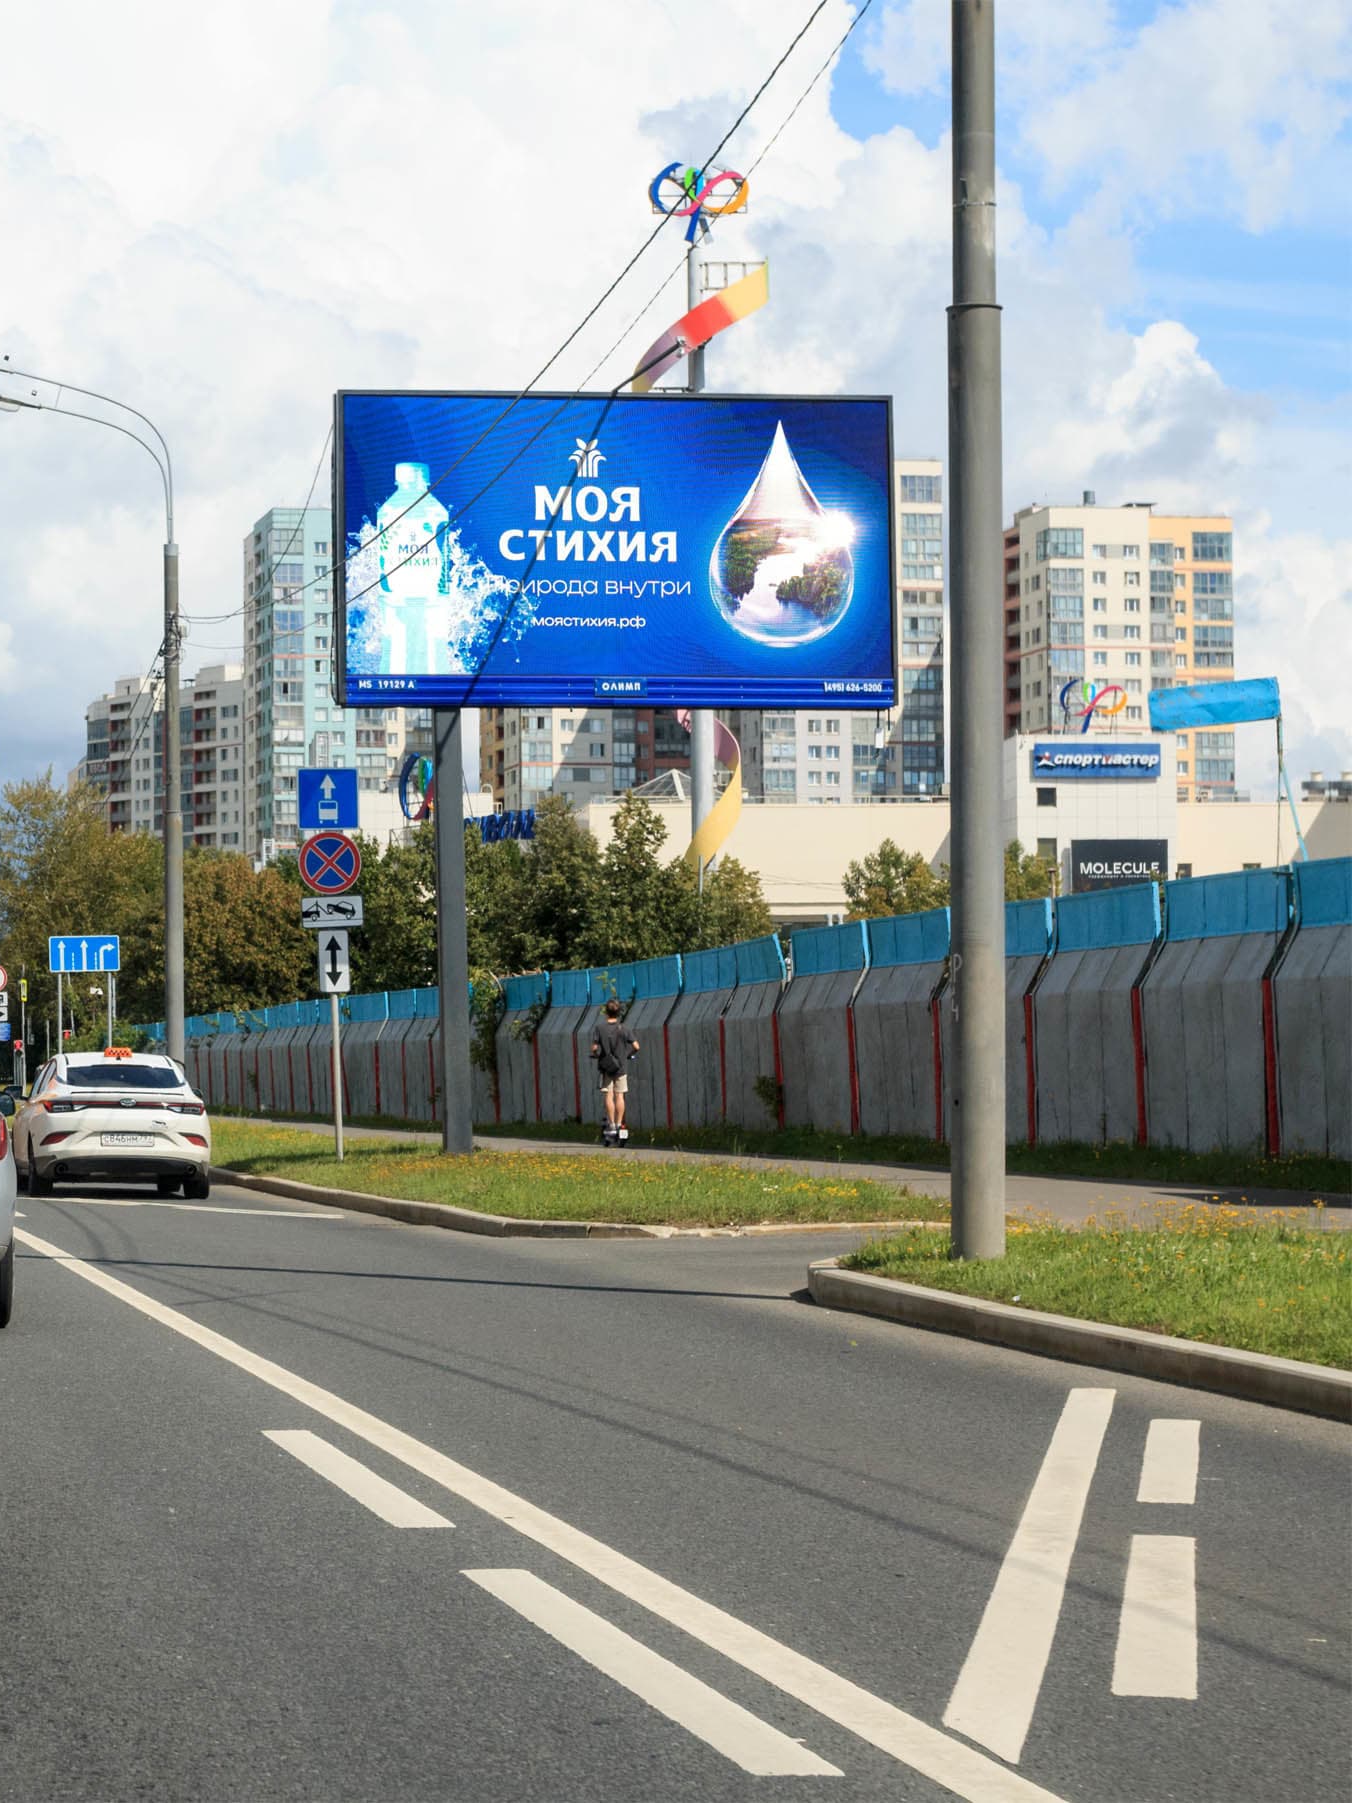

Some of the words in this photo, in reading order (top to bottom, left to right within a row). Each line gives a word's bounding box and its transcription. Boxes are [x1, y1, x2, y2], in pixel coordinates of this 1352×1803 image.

[534, 485, 641, 522] МОЯ
[498, 529, 678, 563] СТИХИЯ
[488, 578, 599, 597] рирода
[605, 579, 692, 599] внутри
[532, 616, 646, 629] моястихия.рф
[378, 680, 406, 690] 19129
[601, 682, 641, 692] ОЛИМП
[1054, 753, 1159, 768] спортмастер
[1079, 862, 1160, 875] MOLECULE
